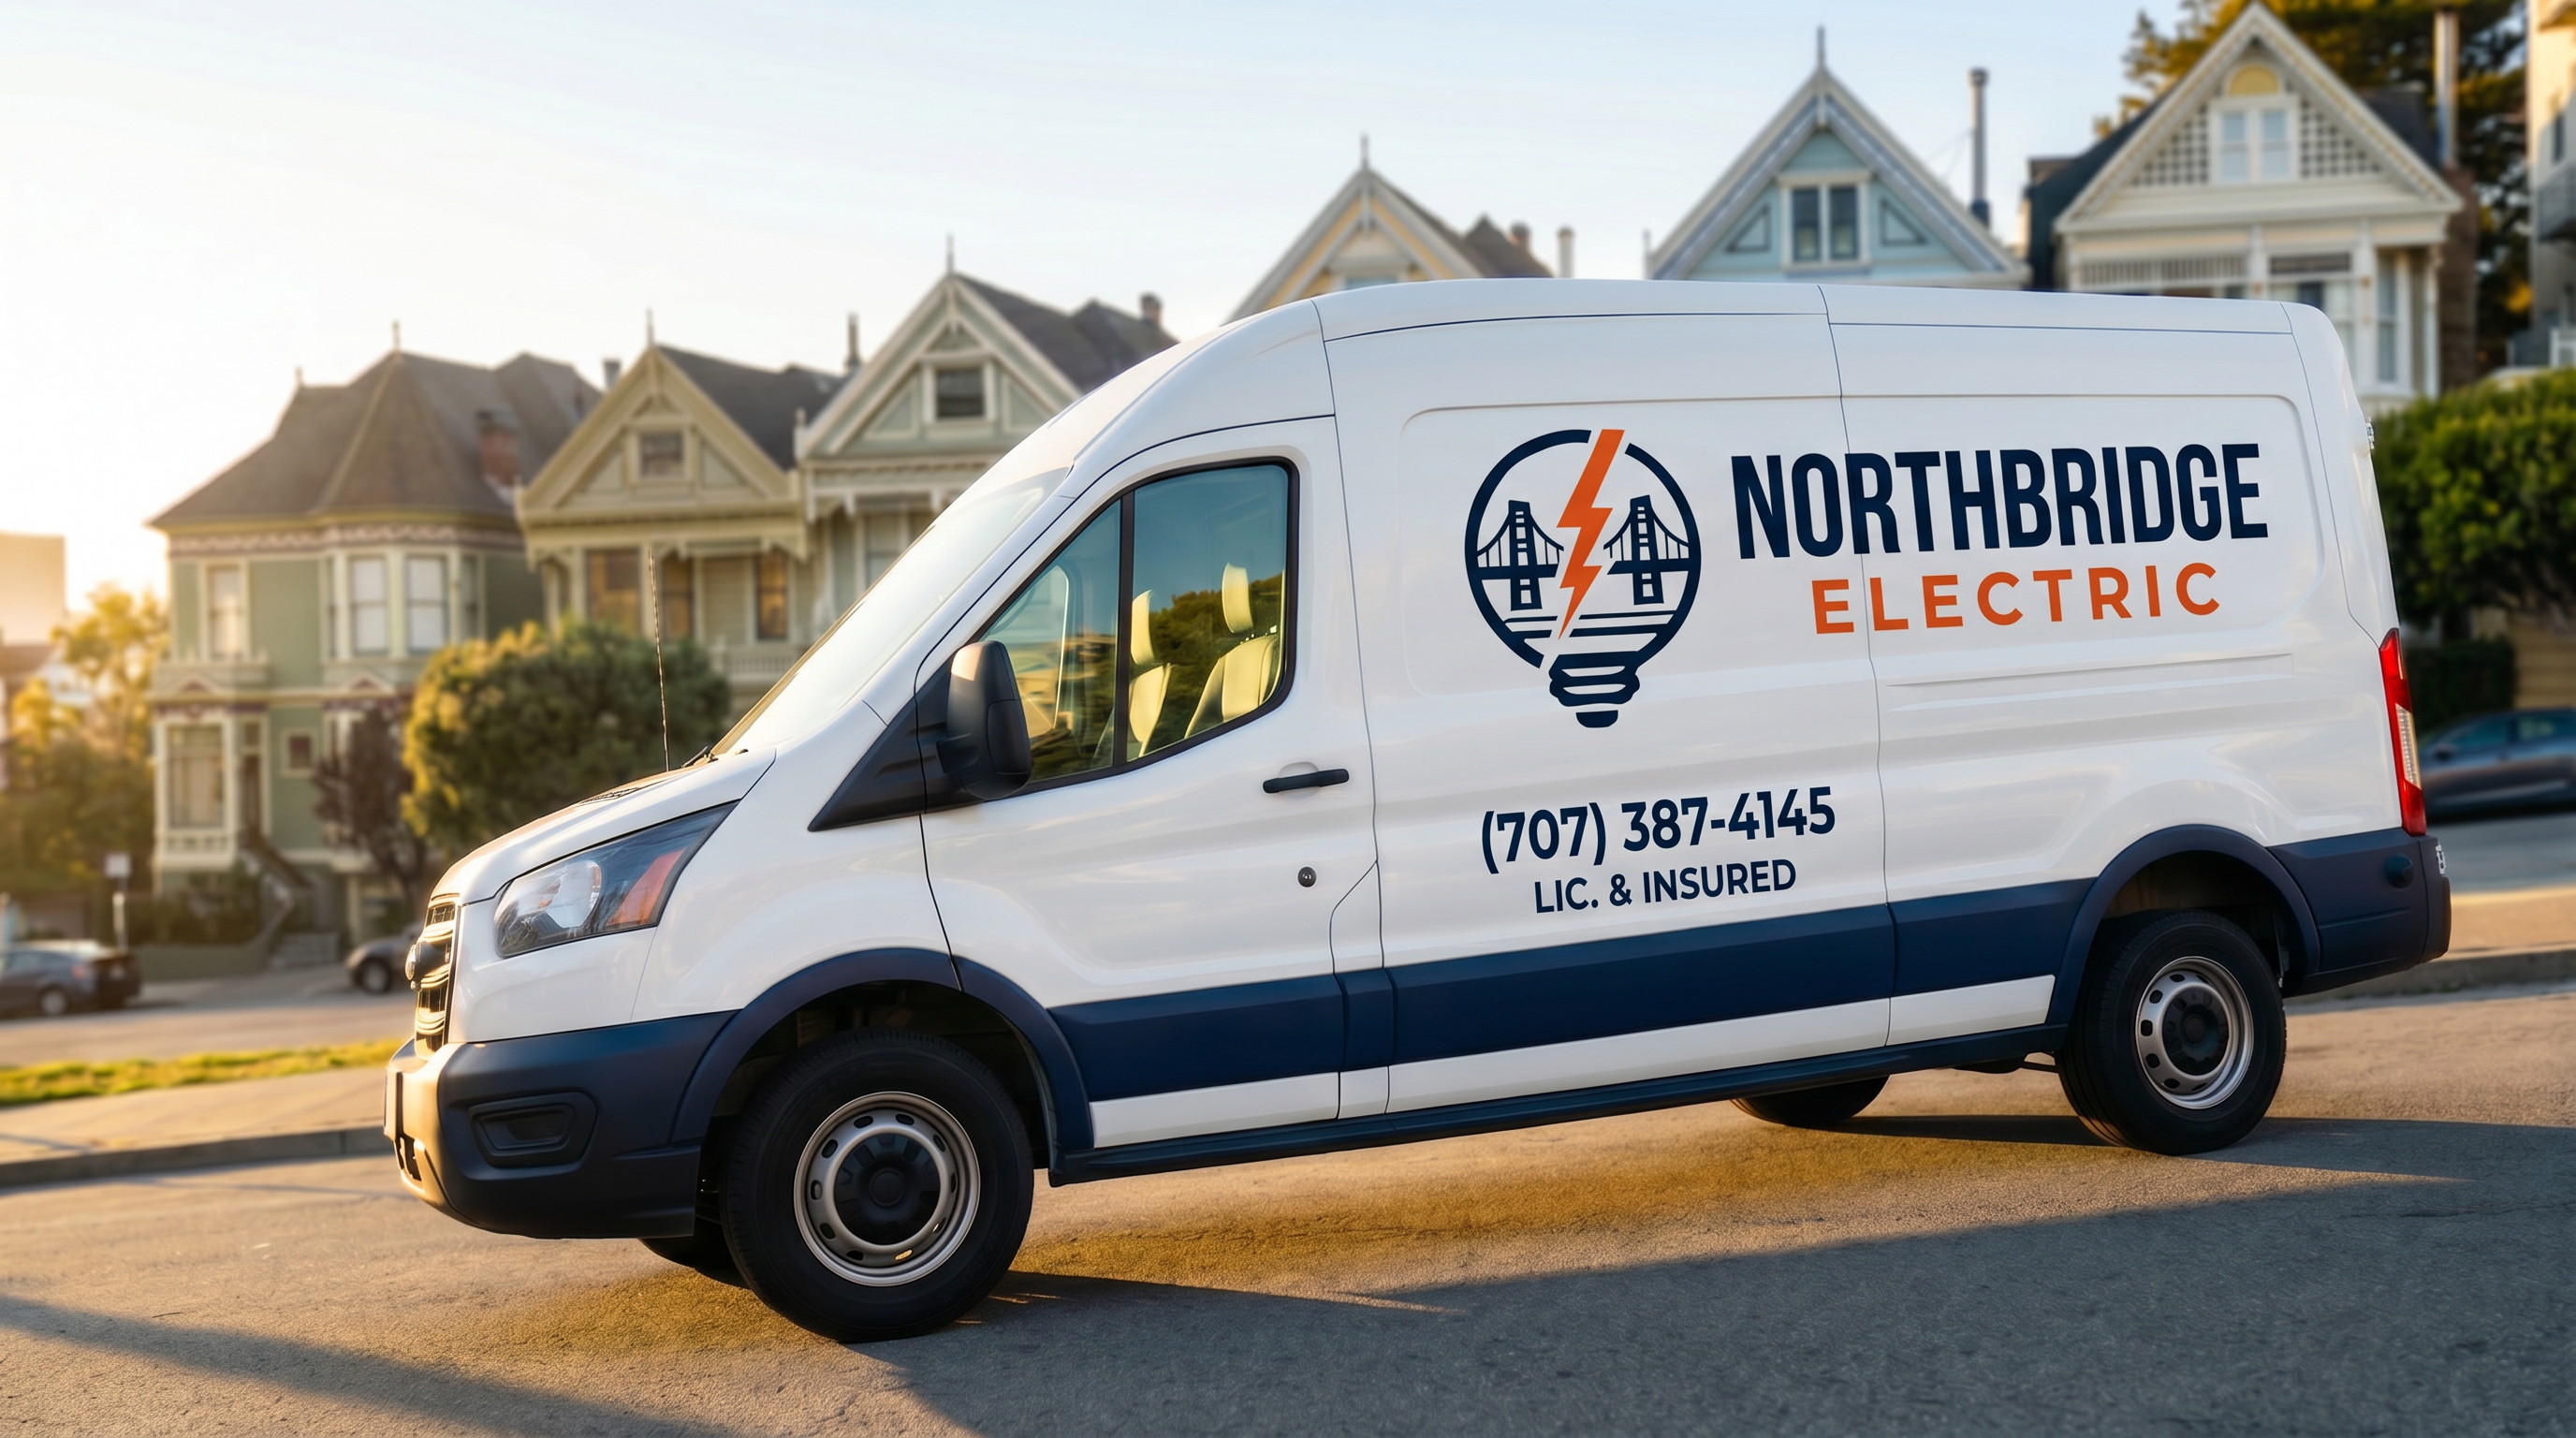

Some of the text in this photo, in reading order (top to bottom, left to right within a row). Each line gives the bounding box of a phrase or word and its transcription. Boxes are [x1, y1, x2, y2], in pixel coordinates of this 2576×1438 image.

[1730, 443, 2269, 560] NORTHBRIDGE
[1811, 562, 2220, 635] ELECTRIC
[1482, 785, 1836, 875] (707) 387-4145
[1534, 858, 1796, 914] LIC. & INSURED
